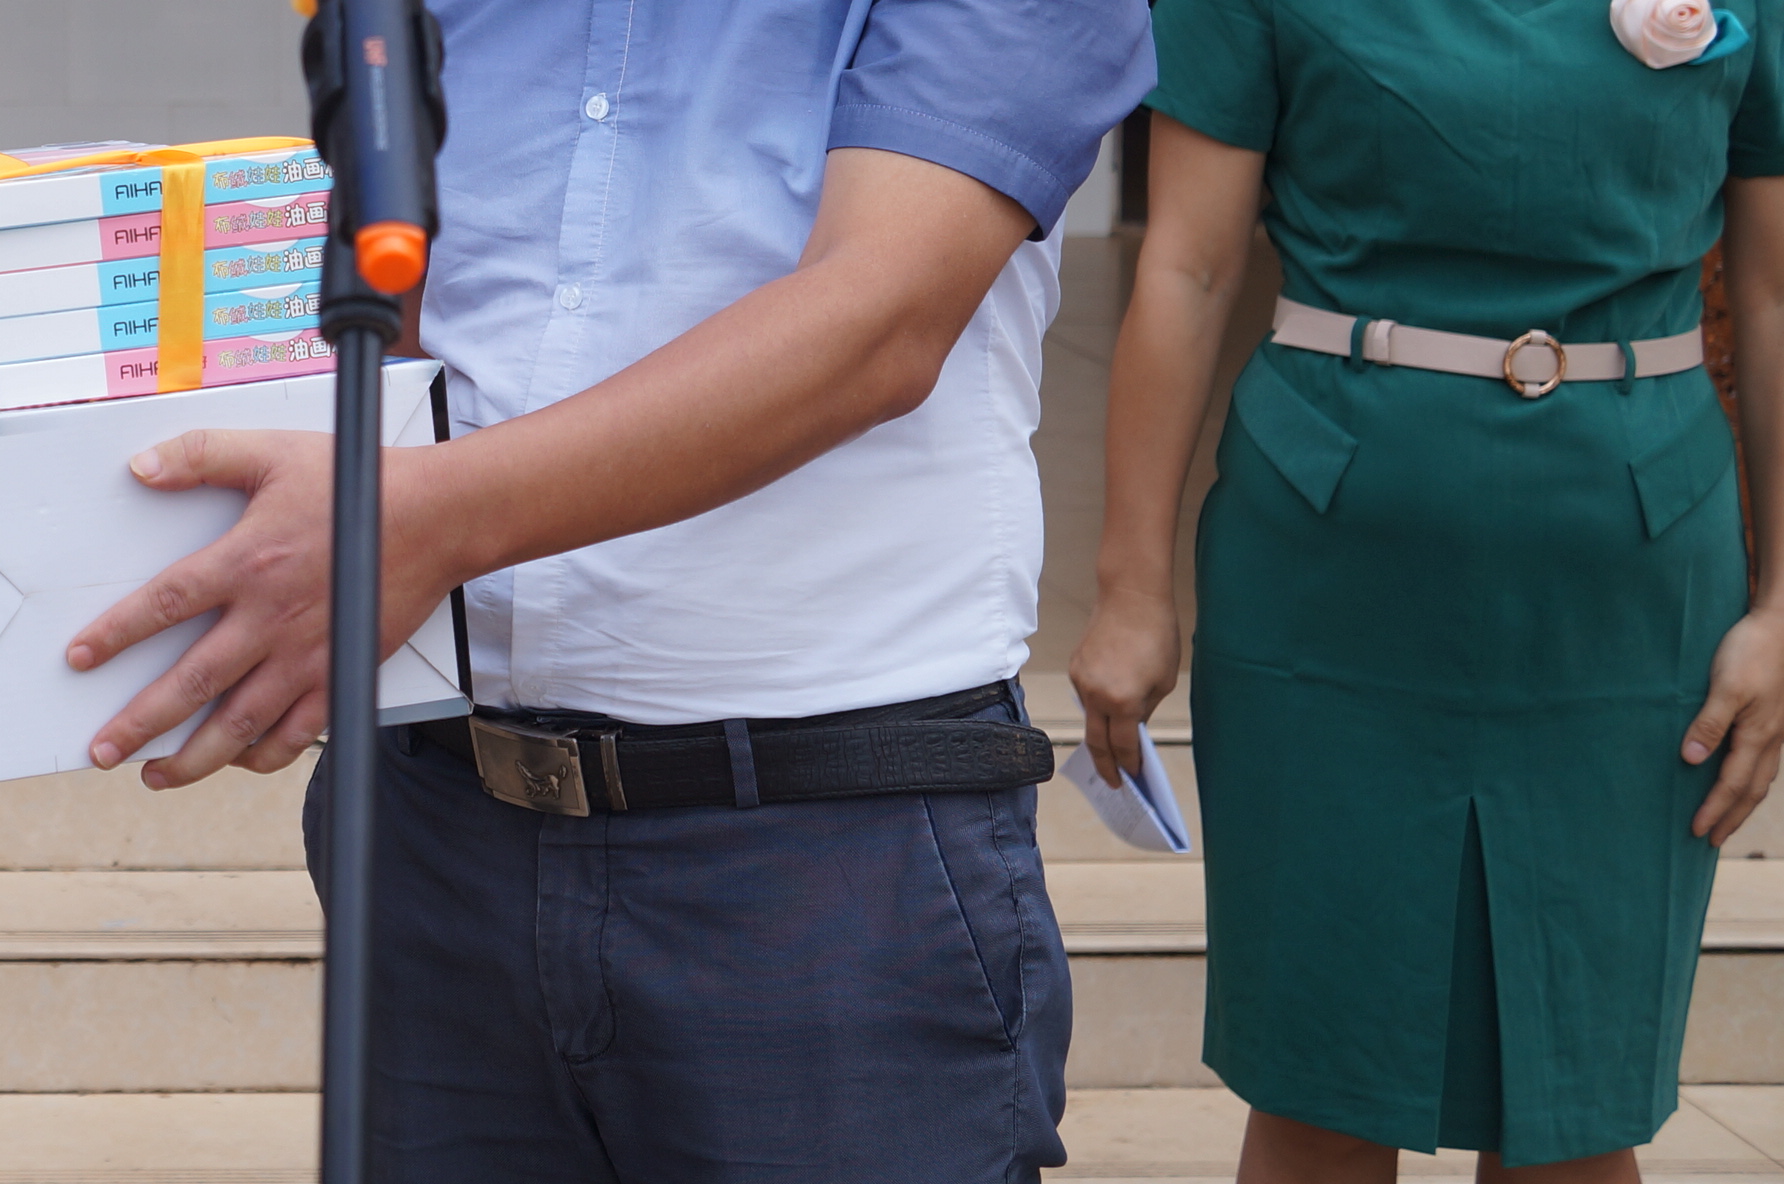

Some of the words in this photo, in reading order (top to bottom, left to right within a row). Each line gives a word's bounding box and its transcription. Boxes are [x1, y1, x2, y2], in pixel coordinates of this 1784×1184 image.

[115, 180, 163, 200] AIHA
[114, 225, 162, 245] AIHA
[213, 201, 328, 234] 布绒娃娃油画
[112, 270, 160, 290] AIHA
[212, 246, 325, 280] 布绒娃娃油画
[113, 317, 159, 337] AIHA
[212, 293, 322, 326] 布绒娃娃油画
[120, 361, 159, 380] AIH
[218, 336, 338, 369] 布绒娃娃油画
